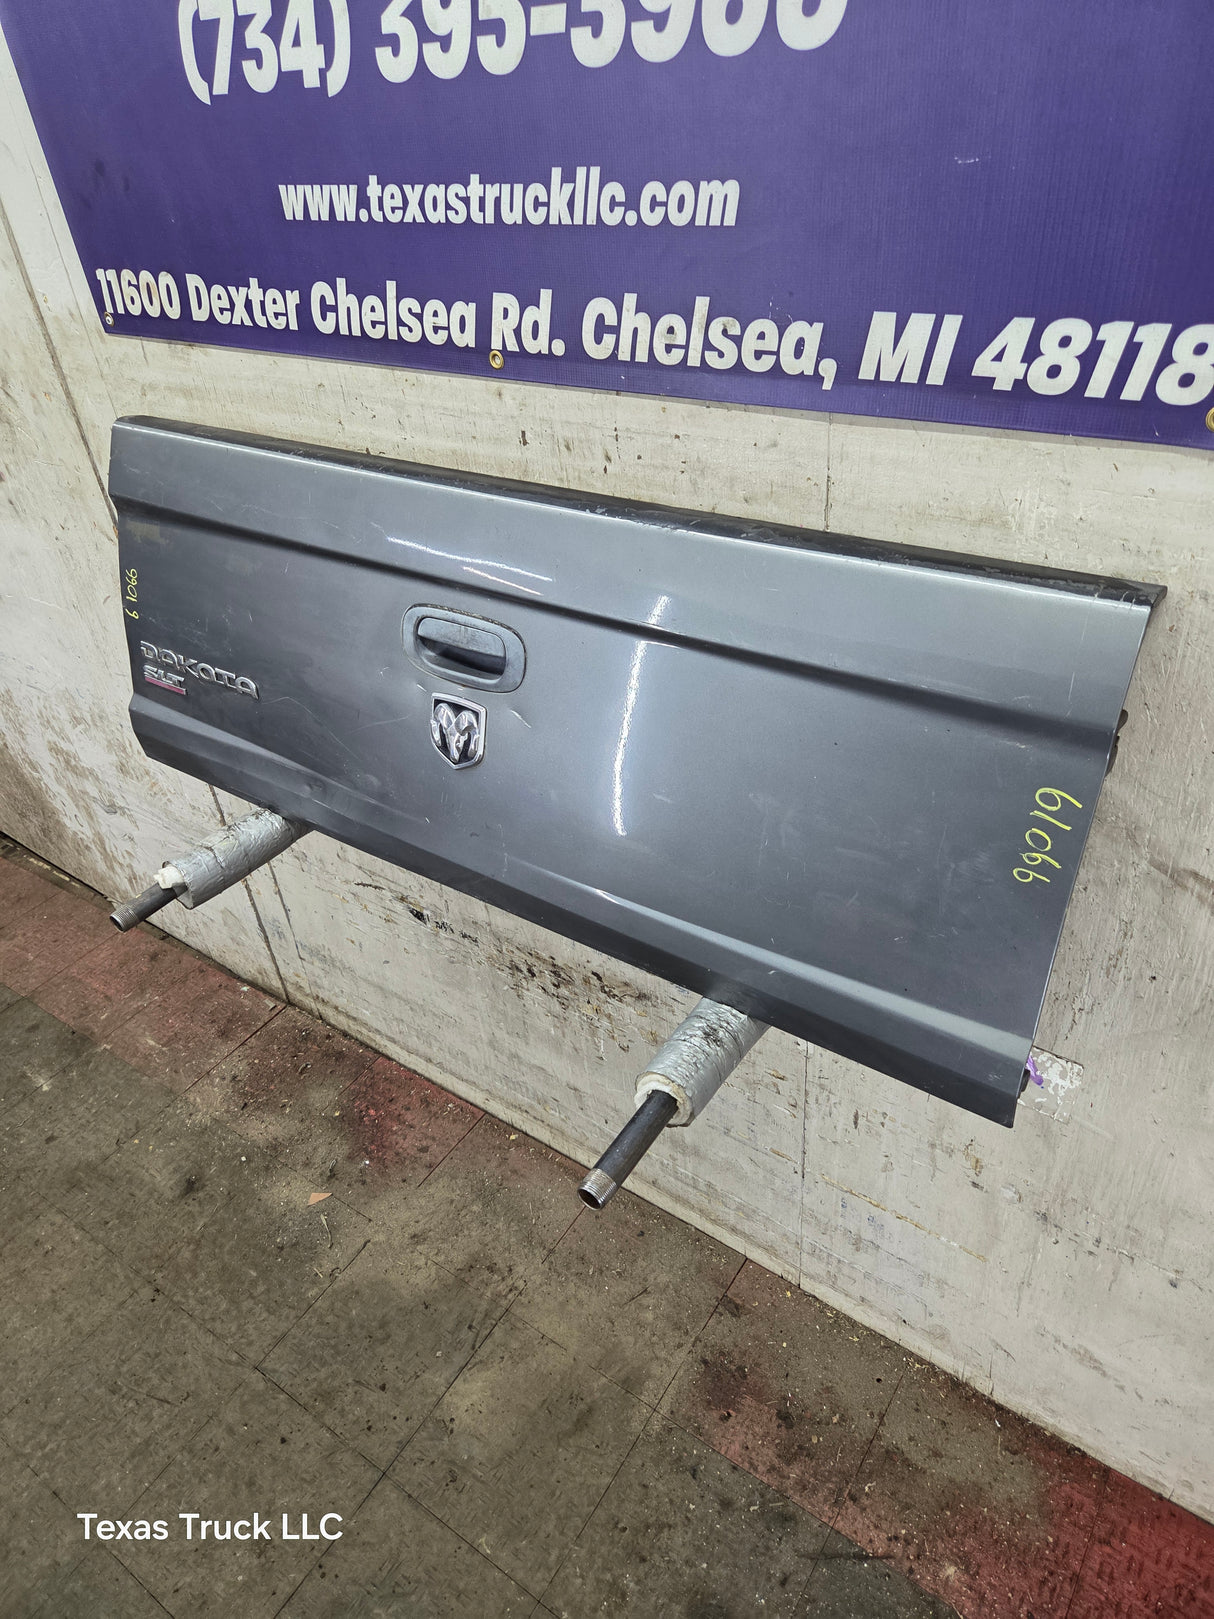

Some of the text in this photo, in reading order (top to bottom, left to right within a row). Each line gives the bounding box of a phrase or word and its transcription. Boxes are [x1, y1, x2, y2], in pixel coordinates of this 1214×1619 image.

[177, 0, 351, 106] (734)
[279, 165, 741, 227] www.texastruckllc.com
[95, 268, 1214, 406] 11600 Dexter Chelsea Rd. Chelsea, MI 48118
[140, 640, 261, 700] DAKOTA
[143, 664, 186, 690] SLT
[1012, 786, 1083, 883] 61066
